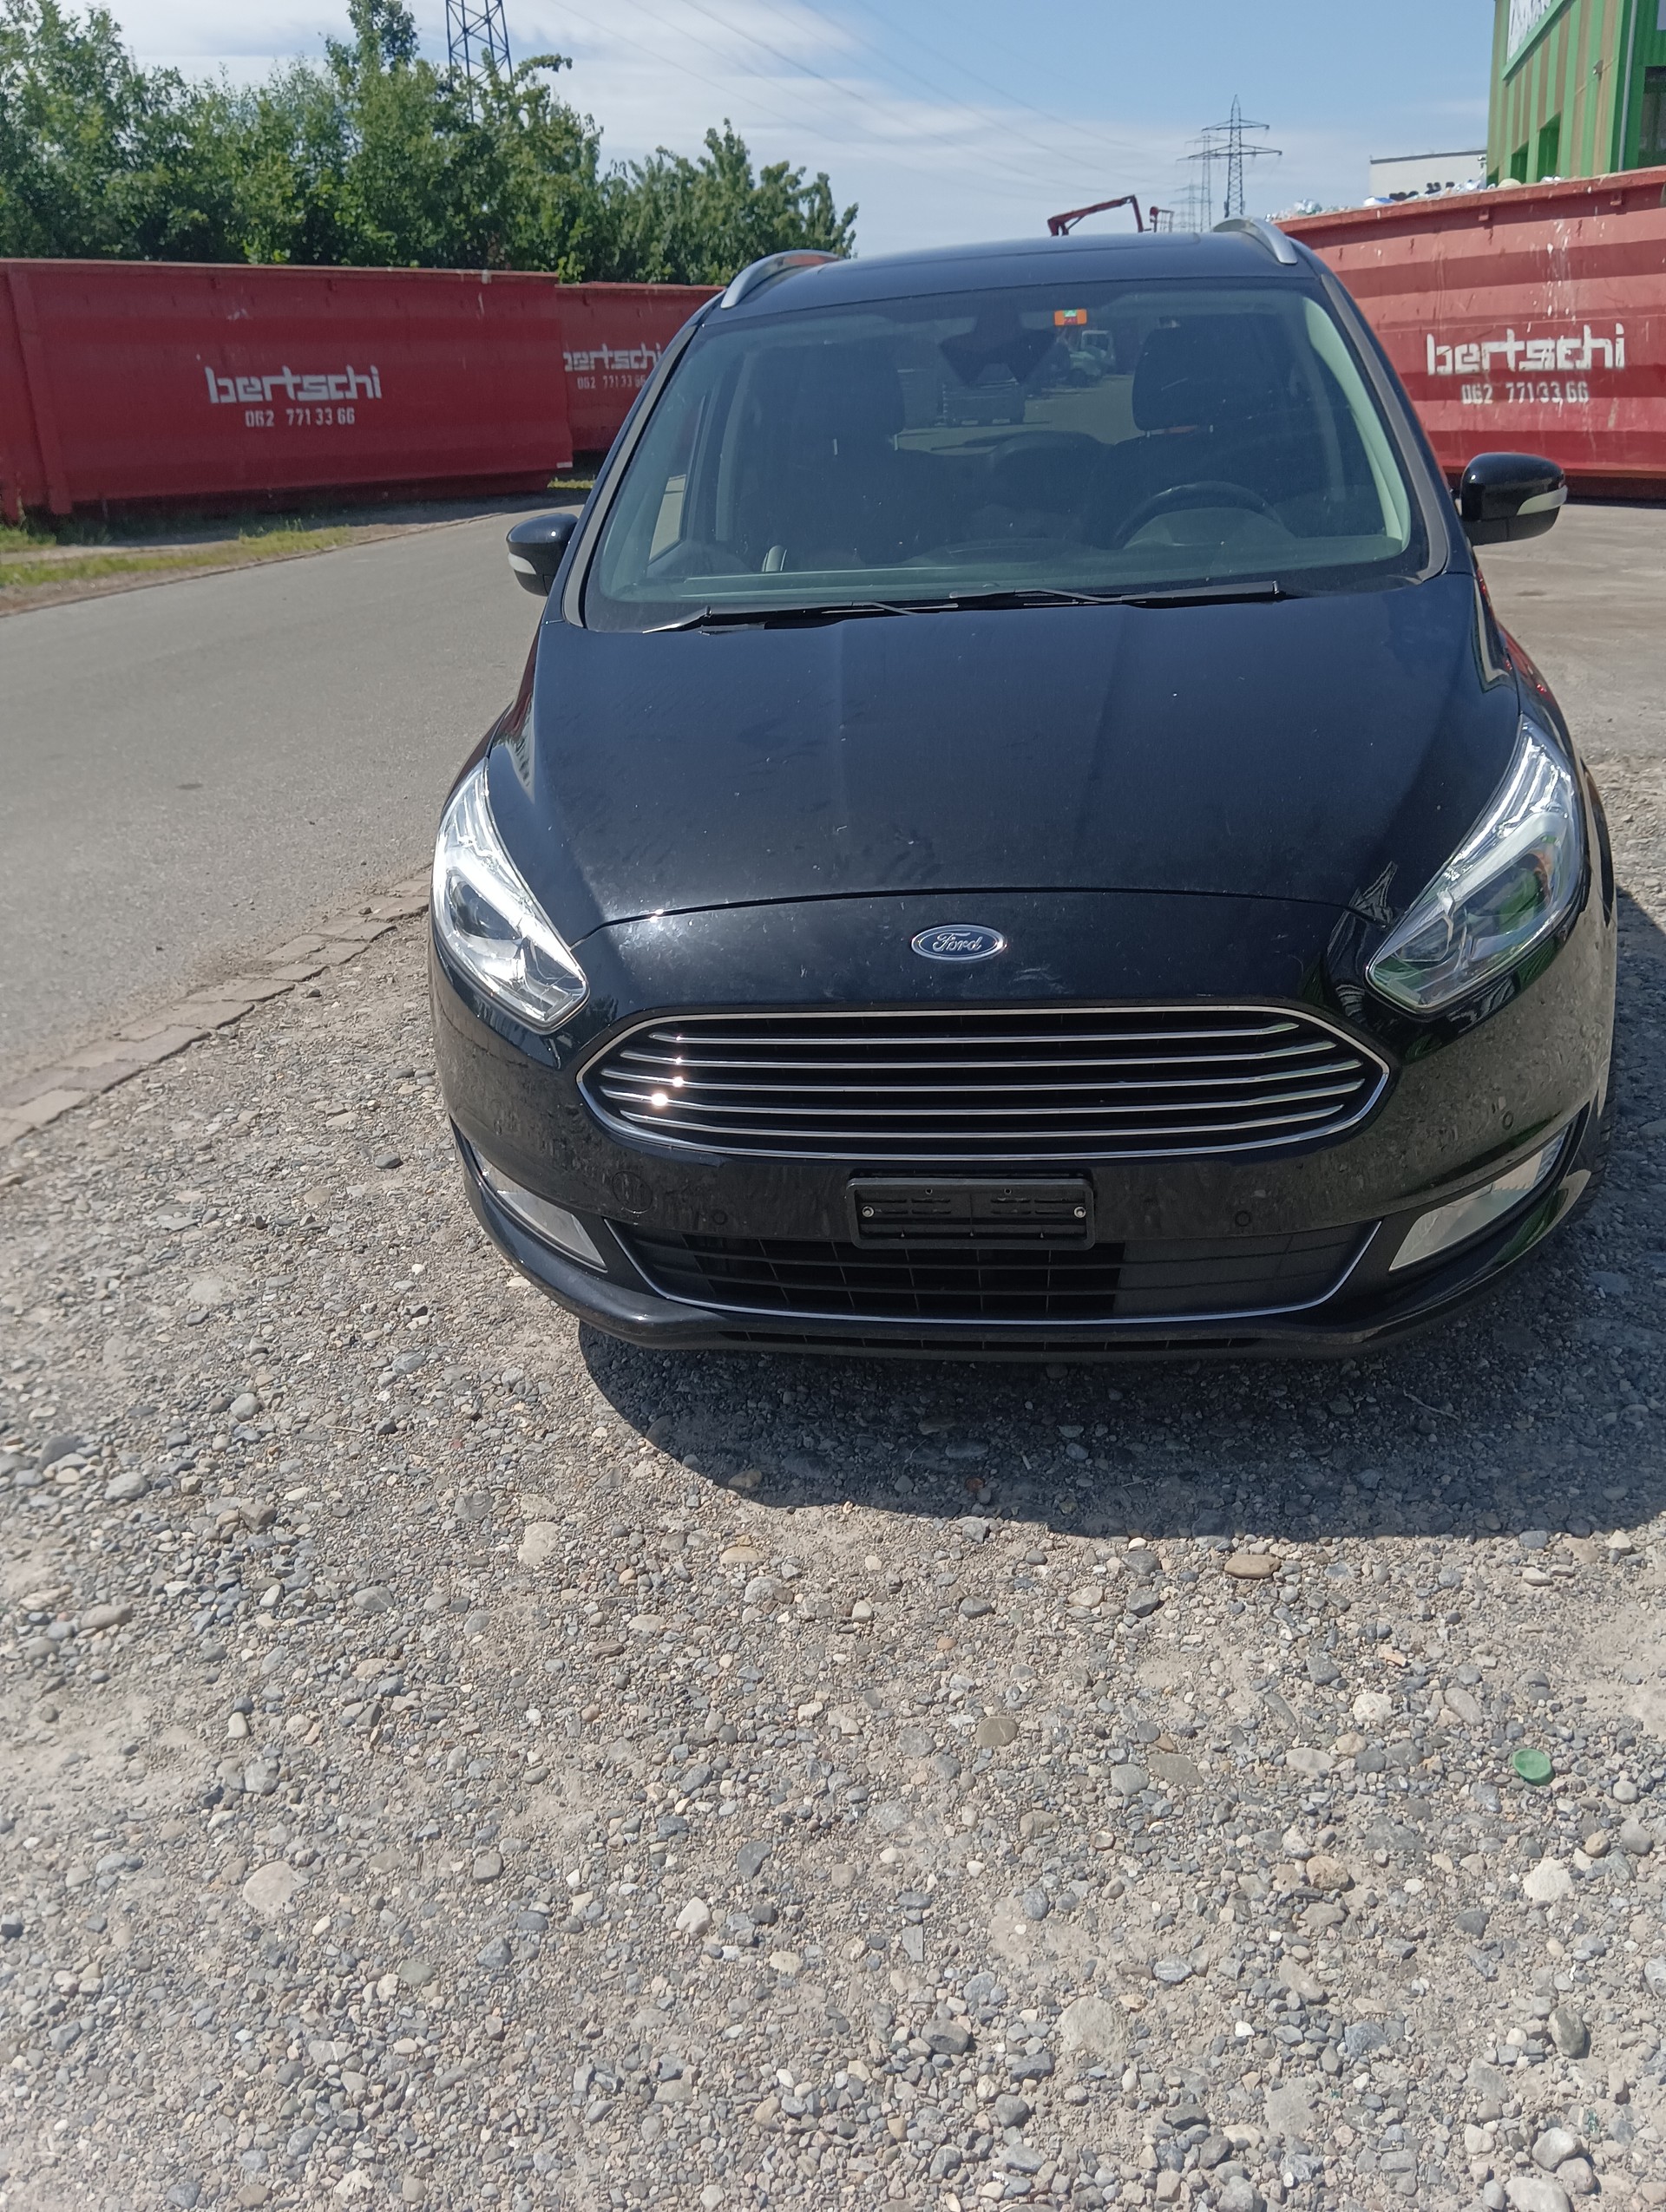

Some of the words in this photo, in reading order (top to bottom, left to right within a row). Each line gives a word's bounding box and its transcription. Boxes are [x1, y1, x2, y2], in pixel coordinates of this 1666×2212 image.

[1427, 323, 1625, 376] bertschi
[204, 365, 383, 403] bertschi
[1461, 383, 1493, 404] 062
[1505, 381, 1534, 403] 771
[1538, 381, 1561, 403] 33
[1565, 381, 1589, 403] 66
[245, 409, 274, 428] 062
[285, 408, 311, 426] 771
[315, 407, 332, 426] 33
[337, 407, 355, 425] 66
[932, 932, 983, 952] Ford
